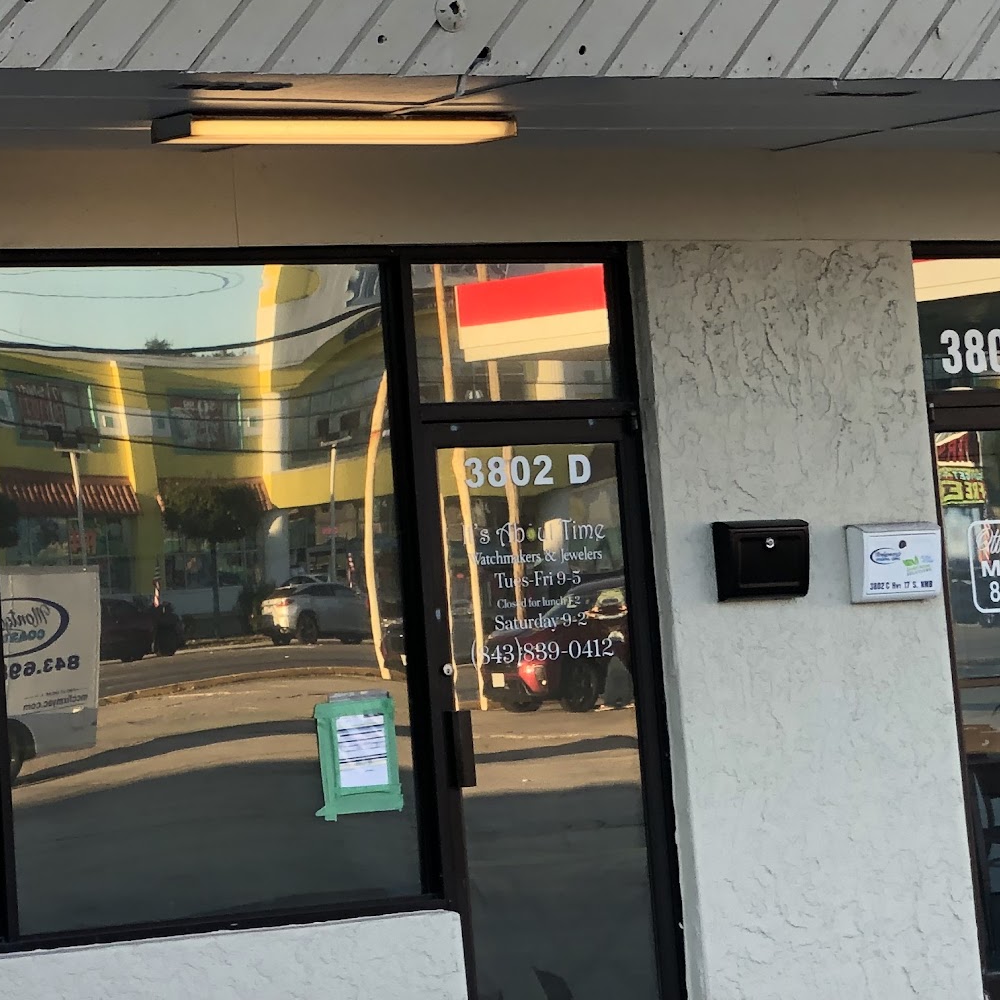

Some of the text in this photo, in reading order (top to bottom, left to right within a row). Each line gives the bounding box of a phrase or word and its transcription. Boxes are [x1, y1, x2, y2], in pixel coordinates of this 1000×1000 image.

[464, 453, 592, 489] 3802 D
[559, 517, 606, 541] Time
[544, 550, 557, 562] &
[560, 546, 603, 564] Jewelers
[494, 570, 582, 589] Tues-Fri 9-5
[496, 598, 527, 609] Closd
[527, 598, 541, 608] for
[494, 611, 588, 632] Saturday 9-2
